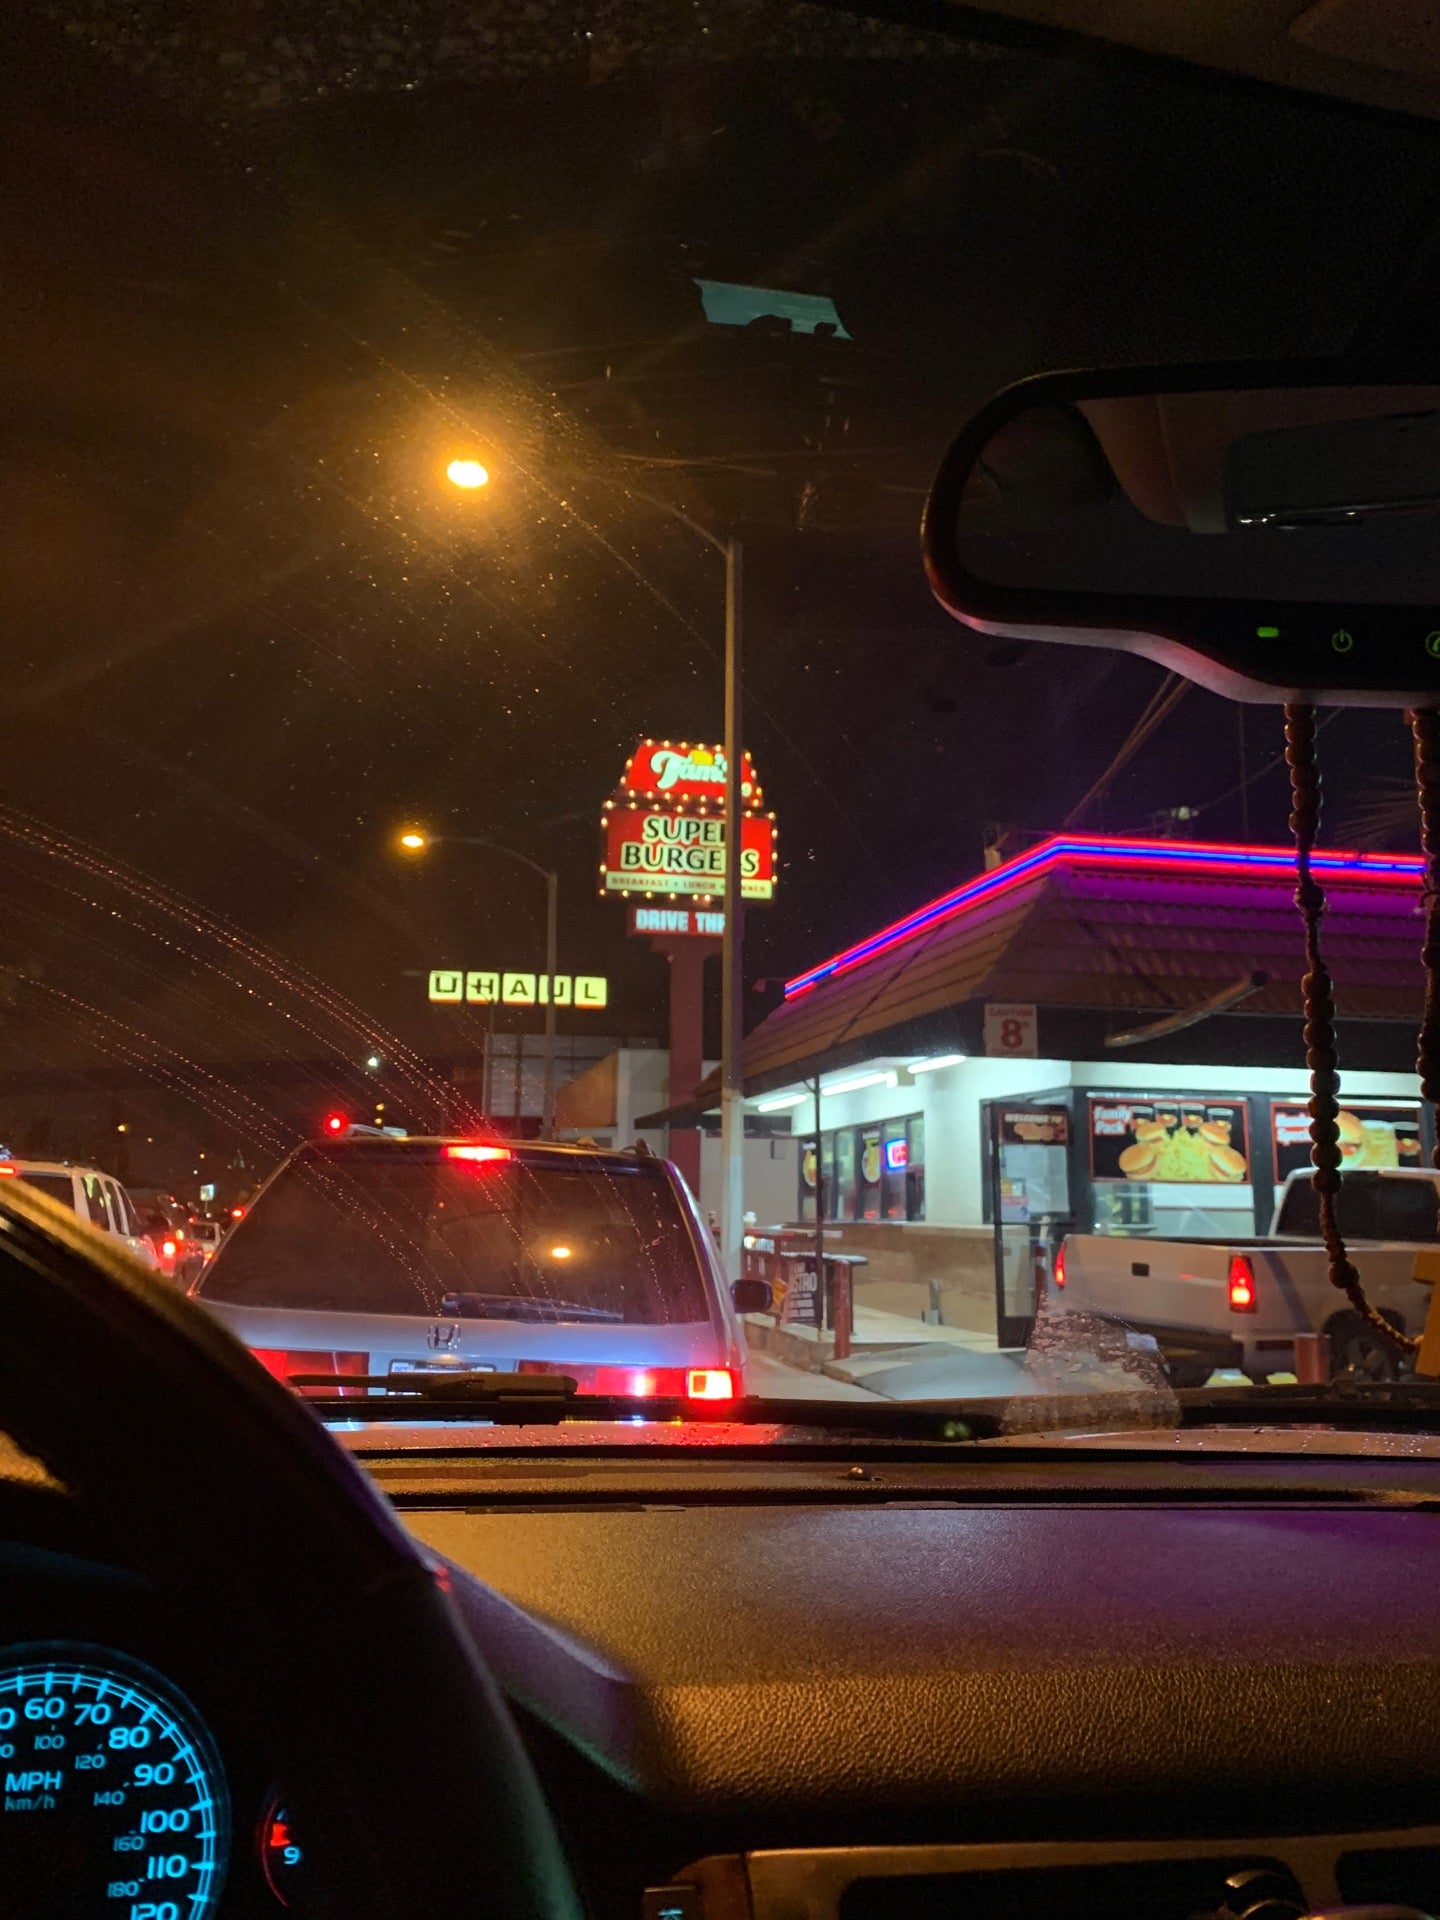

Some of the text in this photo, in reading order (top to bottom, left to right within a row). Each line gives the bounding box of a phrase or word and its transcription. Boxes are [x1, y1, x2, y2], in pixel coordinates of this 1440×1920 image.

[622, 844, 758, 876] BURGES
[612, 877, 669, 887] BREAKFAST
[684, 881, 716, 889] LUNCH
[636, 909, 688, 931] DRIVE
[24, 1698, 65, 1720] 60
[74, 1704, 111, 1726] 70
[34, 1735, 64, 1750] 100
[108, 1727, 150, 1749] 80
[75, 1754, 106, 1769] 120
[5, 1771, 62, 1792] MPH
[134, 1764, 174, 1786] 90
[5, 1795, 55, 1811] km/h
[94, 1791, 125, 1806] 140
[140, 1810, 189, 1833] 100
[113, 1836, 145, 1850] 160
[284, 1848, 300, 1864] 9
[147, 1856, 188, 1879] 110
[108, 1882, 139, 1898] 180
[130, 1902, 178, 1920] 120
